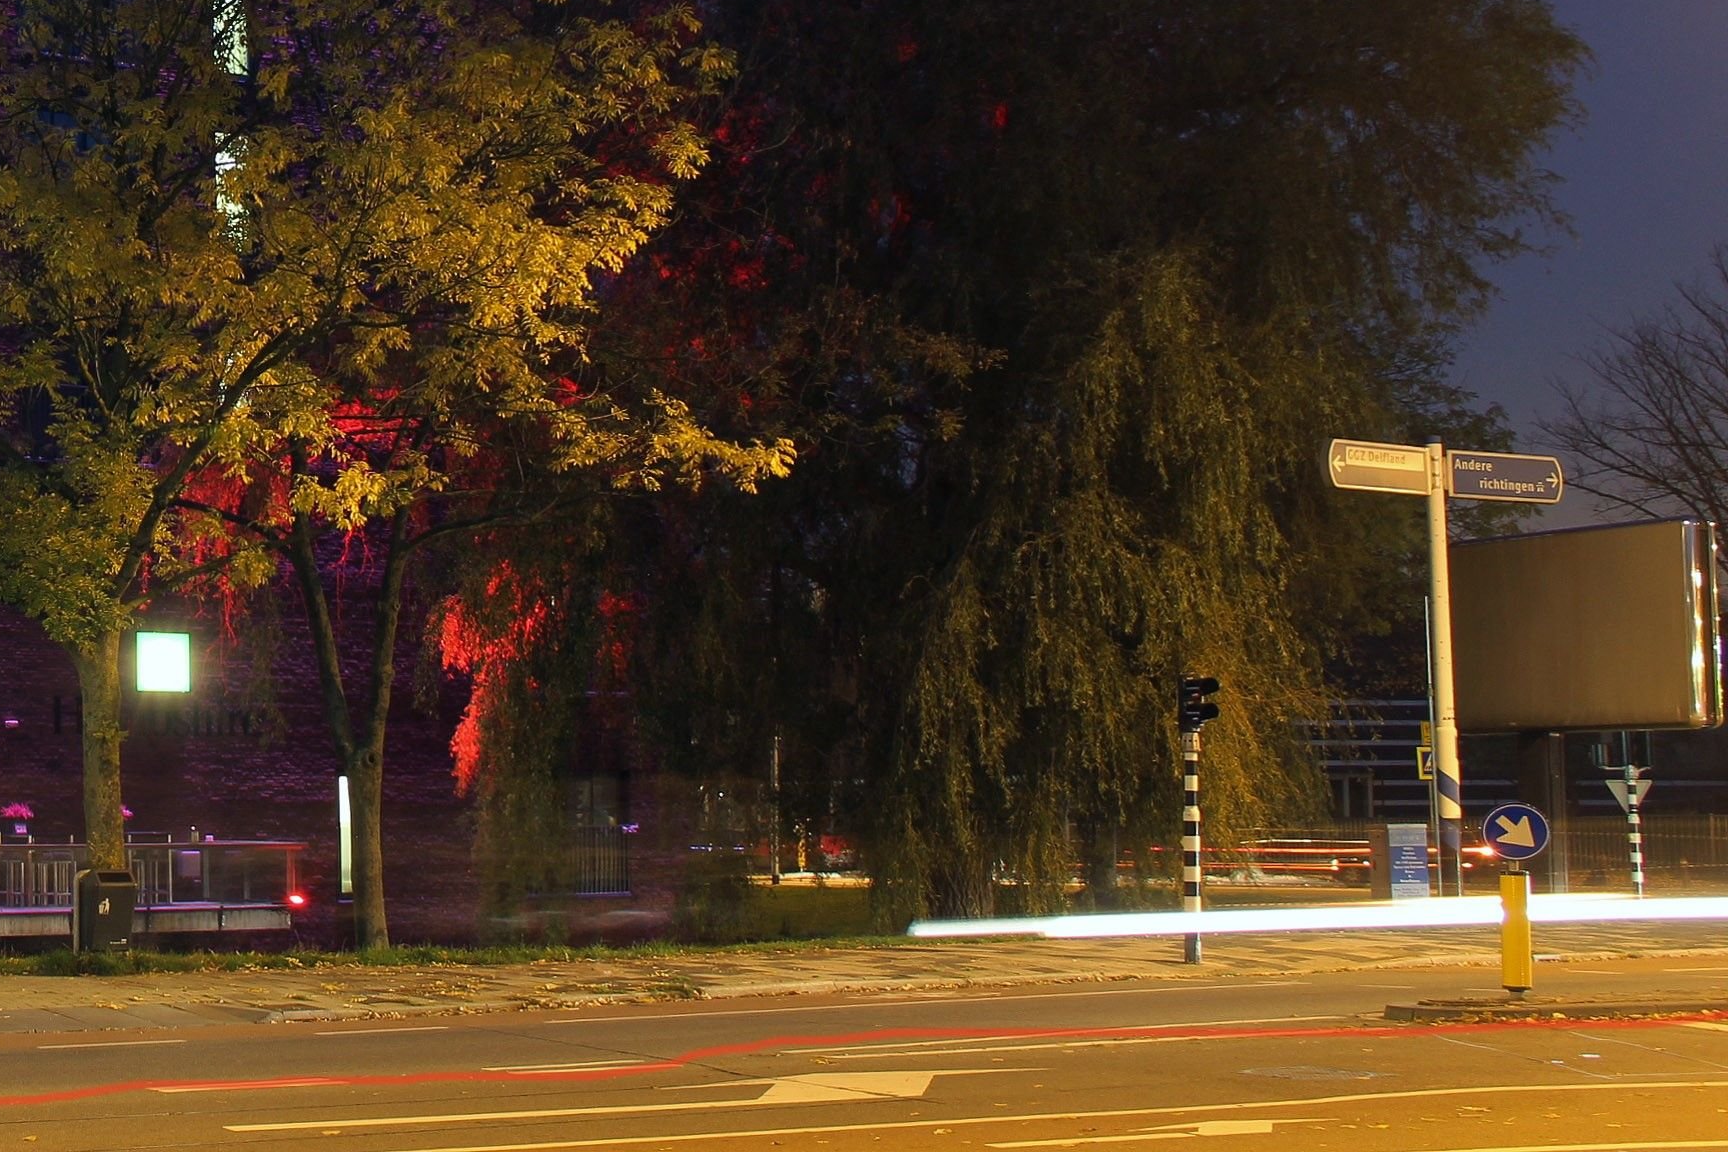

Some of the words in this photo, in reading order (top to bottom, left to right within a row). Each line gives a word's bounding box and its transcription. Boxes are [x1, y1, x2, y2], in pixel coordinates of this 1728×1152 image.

[1368, 450, 1407, 465] Delfland
[1454, 458, 1493, 472] Andere
[1479, 476, 1535, 494] richtingen
